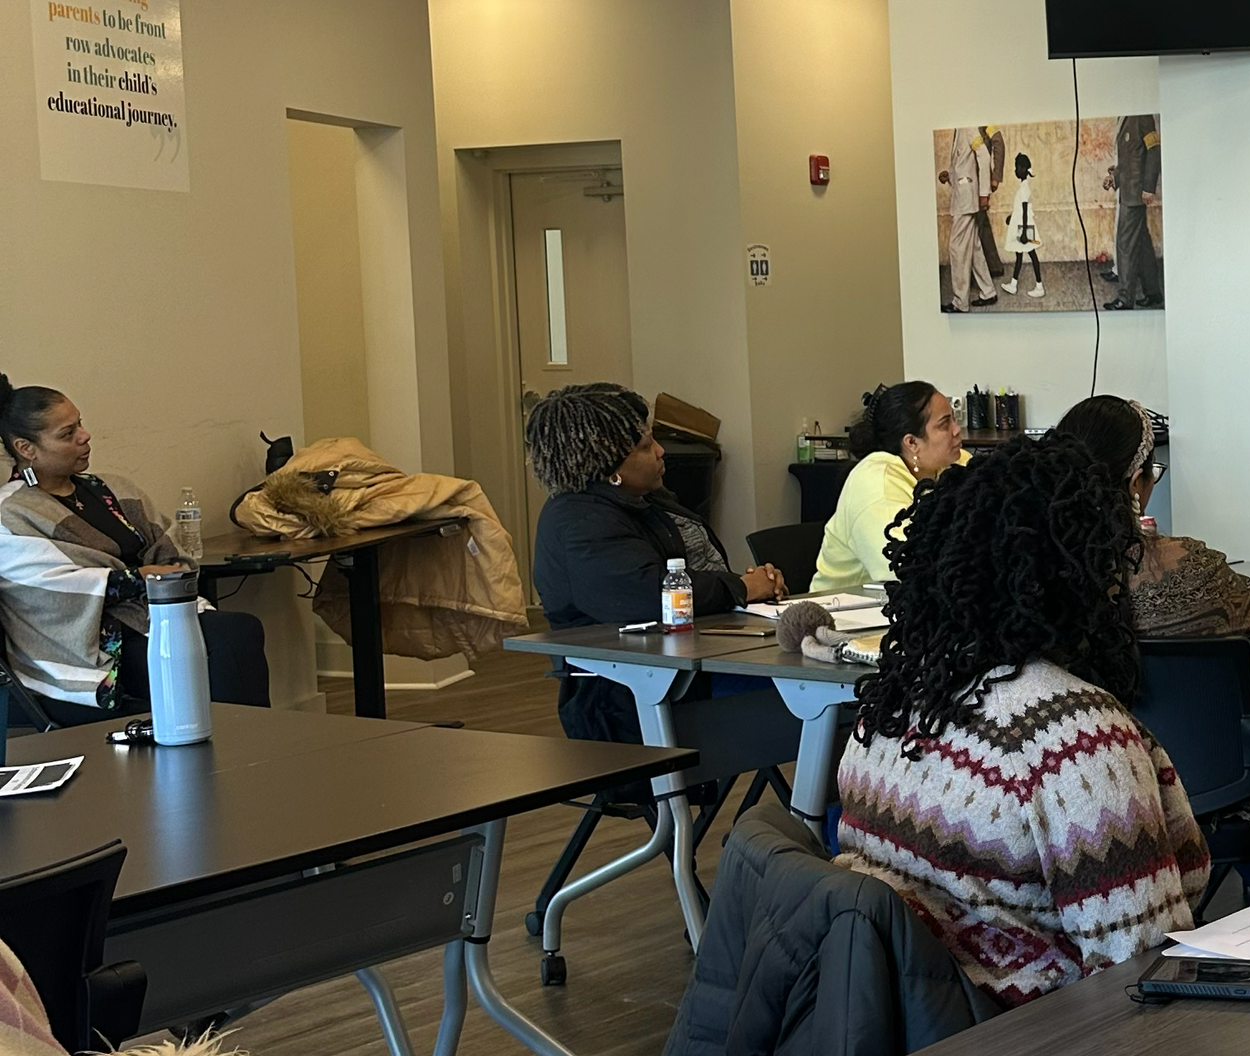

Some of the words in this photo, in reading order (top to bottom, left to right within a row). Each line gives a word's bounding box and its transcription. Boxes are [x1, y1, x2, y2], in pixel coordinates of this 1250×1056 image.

[48, 1, 101, 25] parents
[103, 10, 116, 28] to
[118, 10, 133, 32] be
[135, 14, 166, 39] front
[66, 36, 92, 54] row
[95, 37, 156, 66] advocates
[67, 62, 81, 83] in
[83, 65, 117, 88] their
[118, 71, 157, 96] child's
[48, 91, 125, 121] educational
[126, 102, 177, 132] journey.
